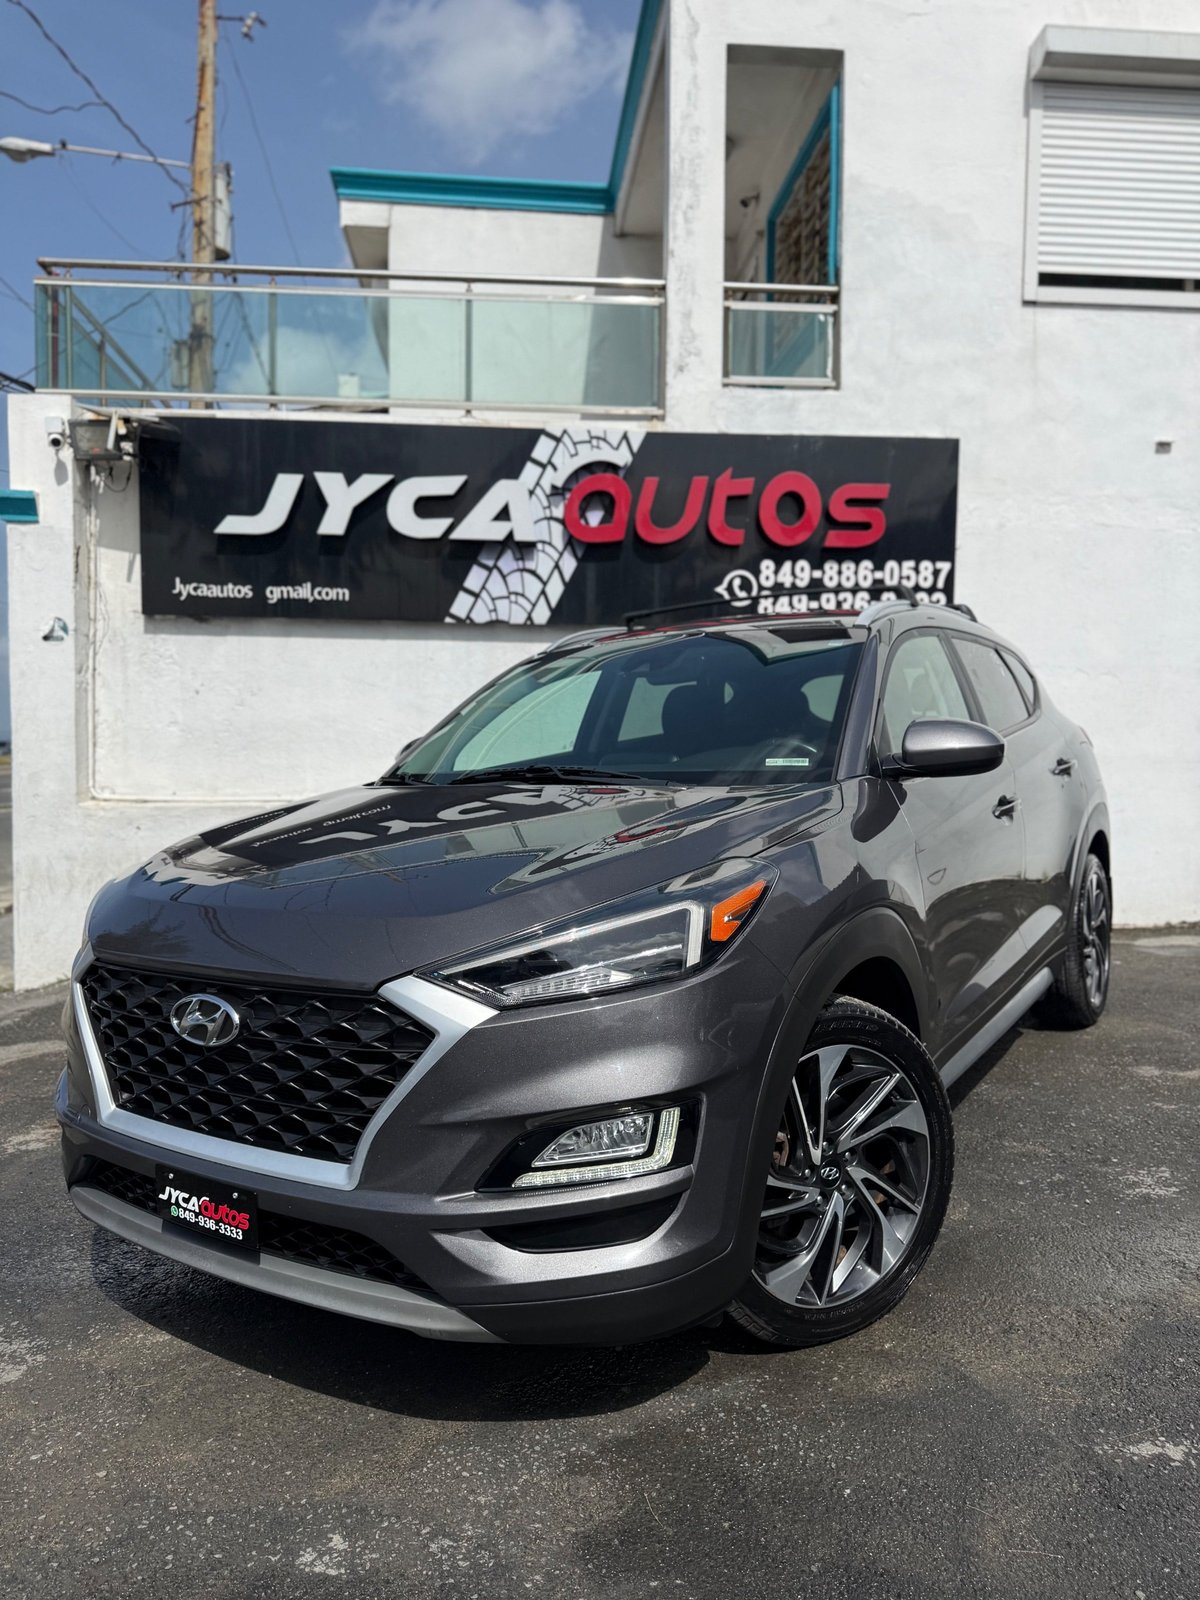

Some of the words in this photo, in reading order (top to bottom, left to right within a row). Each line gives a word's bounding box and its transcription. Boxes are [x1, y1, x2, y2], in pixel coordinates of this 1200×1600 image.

[172, 576, 253, 601] Jycaautos
[758, 558, 952, 589] 849-886-0587
[178, 1207, 243, 1240] 849-936-3333
